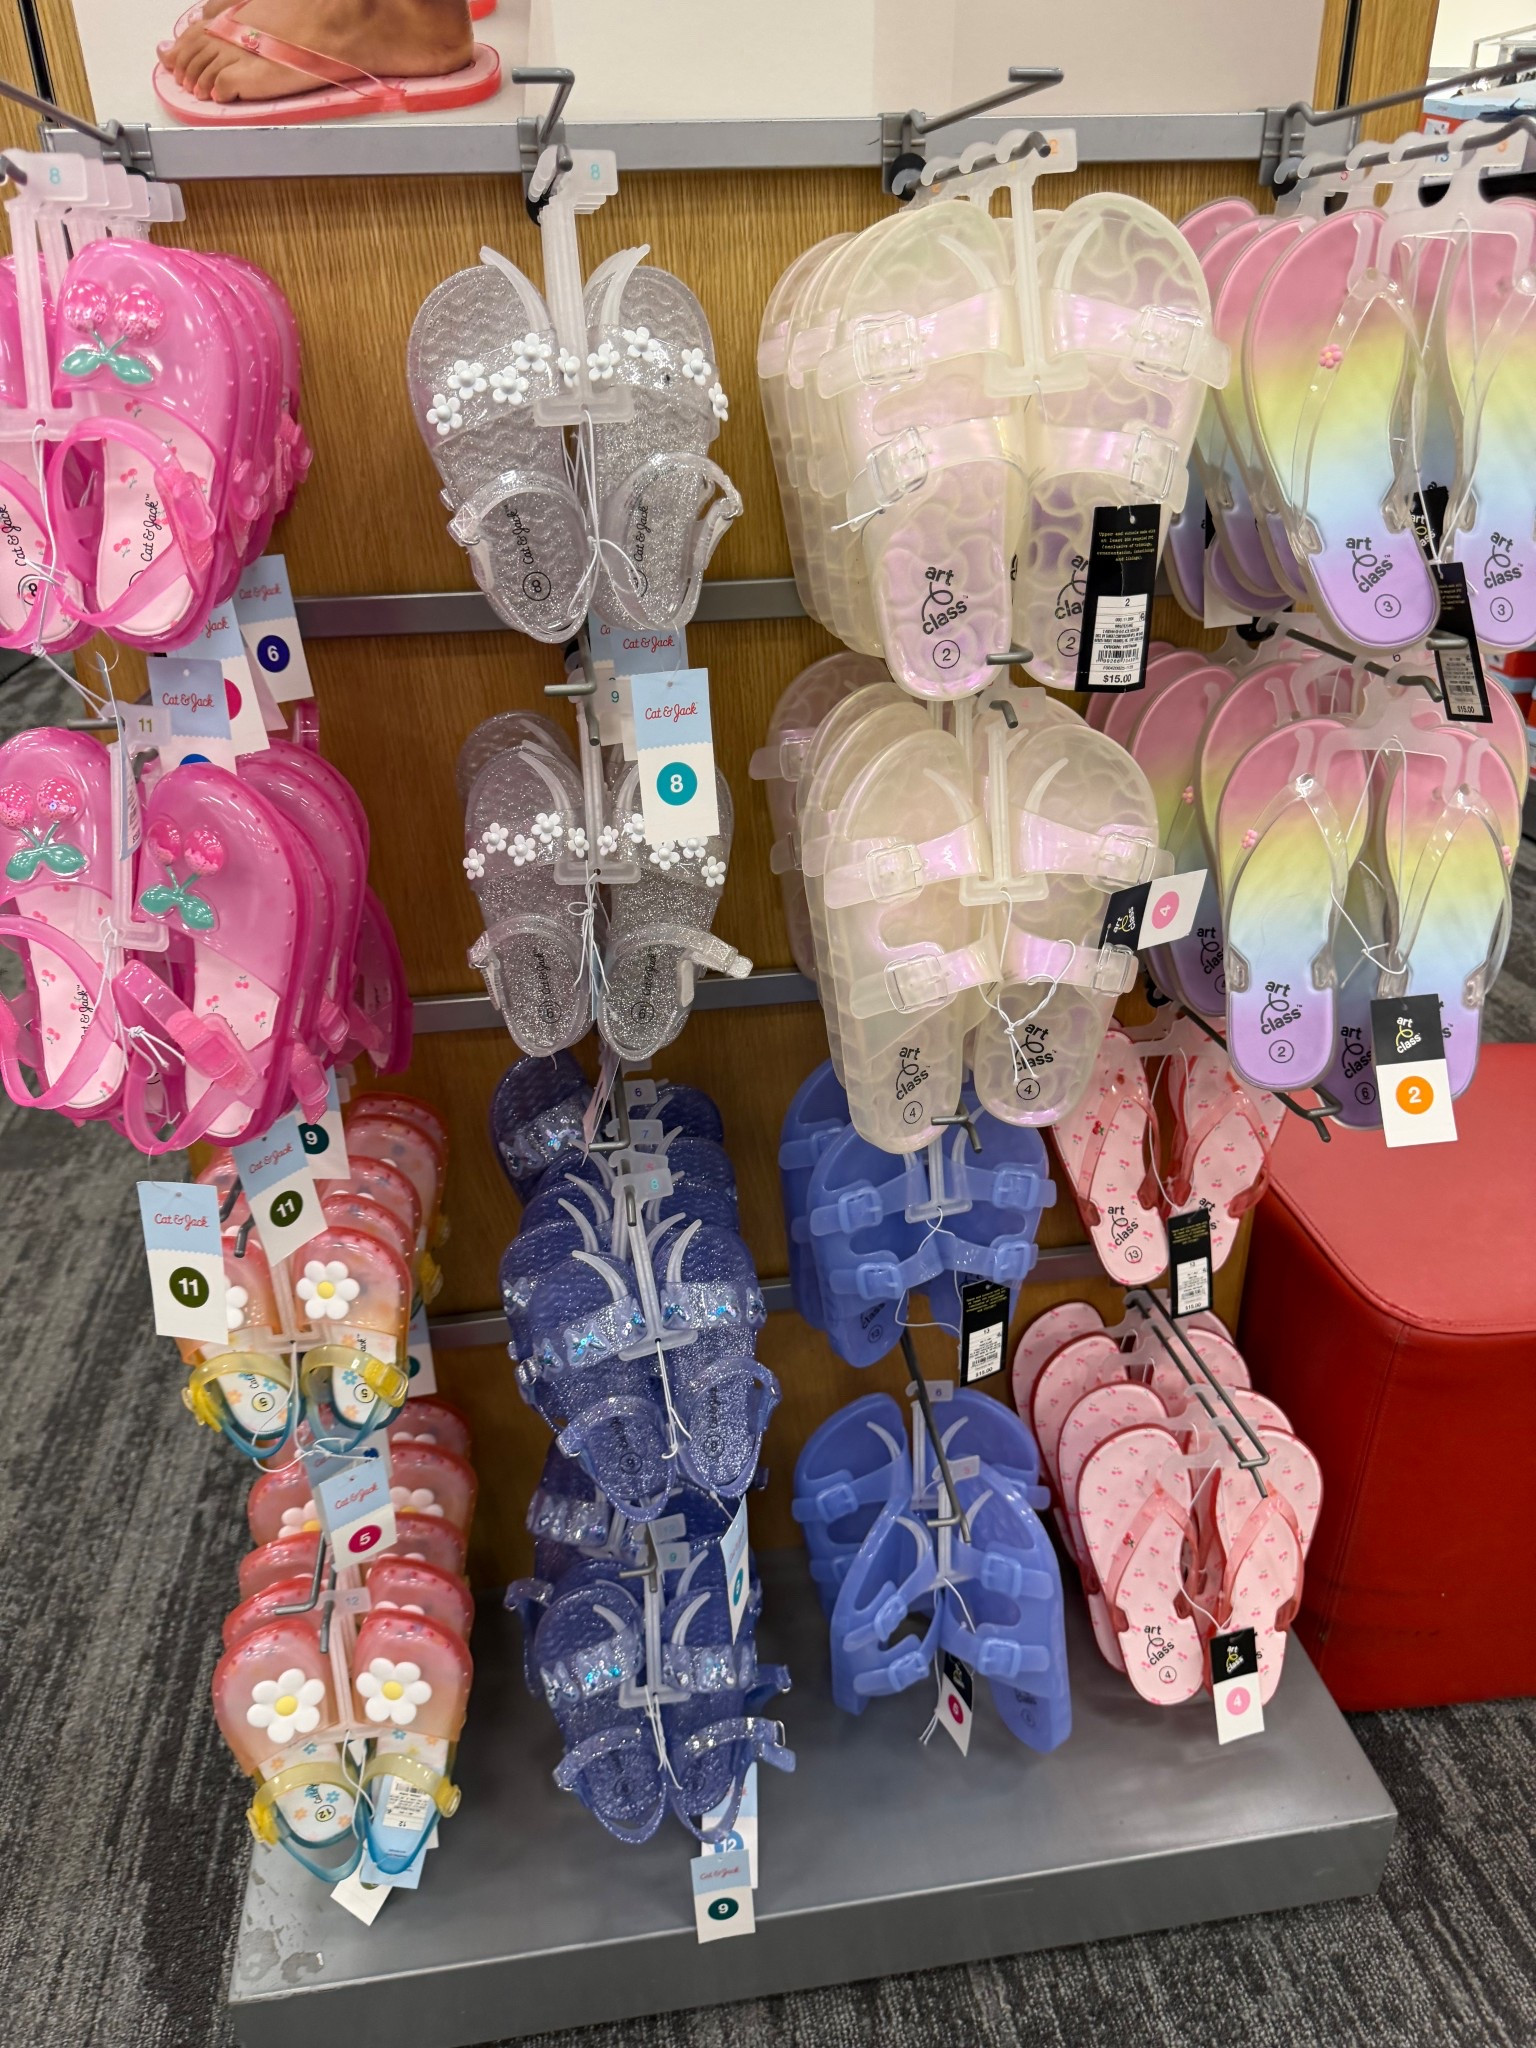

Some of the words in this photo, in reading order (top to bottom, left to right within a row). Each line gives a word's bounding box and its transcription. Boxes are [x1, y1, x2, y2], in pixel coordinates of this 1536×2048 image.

[50, 167, 61, 184] 8
[590, 164, 600, 180] 8
[143, 501, 162, 531] Jack
[507, 509, 530, 534] Jack
[637, 505, 651, 533] Jack
[8, 535, 19, 545] &
[143, 529, 155, 540] &
[517, 536, 527, 546] &
[636, 533, 646, 543] &
[1346, 537, 1372, 551] art
[1490, 532, 1514, 552] art
[141, 544, 153, 562] Cat
[522, 546, 534, 564] Cat
[633, 544, 645, 561] Cat
[1071, 555, 1088, 572] ar
[925, 566, 954, 586] art
[1358, 559, 1393, 593] class
[1484, 567, 1522, 589] class
[239, 588, 252, 599] Cat
[262, 584, 282, 601] Jack
[532, 580, 541, 593] 8
[1125, 598, 1131, 607] 2
[1382, 601, 1393, 612] 3
[1054, 600, 1084, 620] cla
[1497, 604, 1506, 616] 3
[923, 600, 968, 635] class
[623, 638, 639, 649] Cat
[640, 637, 651, 648] &
[650, 635, 675, 653] Jack
[1066, 637, 1075, 649] 2
[267, 645, 280, 662] 6
[942, 648, 951, 661] 2
[1103, 674, 1132, 683] $15.00
[162, 693, 180, 705] Cat
[181, 696, 191, 706] &
[190, 693, 215, 712] Jack
[611, 690, 619, 703] 9
[645, 707, 662, 720] Cat
[663, 706, 673, 717] &
[673, 702, 698, 723] Jack
[138, 718, 152, 732] 11
[669, 774, 684, 794] 8
[1160, 904, 1171, 917] 4
[1113, 917, 1123, 933] art
[1197, 927, 1216, 939] art
[1265, 981, 1290, 997] art
[80, 1014, 90, 1024] &
[1260, 1007, 1302, 1035] class
[1396, 1016, 1413, 1028] art
[1025, 1024, 1049, 1040] art
[1340, 1026, 1362, 1040] art
[1396, 1034, 1422, 1054] class
[899, 1047, 920, 1060] art
[1278, 1046, 1286, 1058] 2
[1013, 1052, 1054, 1072] class
[896, 1069, 929, 1100] class
[1023, 1084, 1032, 1094] 4
[635, 1087, 642, 1098] 6
[1408, 1086, 1422, 1104] 2
[909, 1108, 916, 1117] 4
[306, 1131, 317, 1145] 9
[249, 1159, 263, 1174] Cat
[264, 1155, 273, 1165] &
[273, 1143, 293, 1166] Jack
[651, 1178, 659, 1190] 8
[276, 1199, 295, 1218] 11
[1107, 1204, 1125, 1215] art
[1199, 1197, 1216, 1212] art
[154, 1213, 173, 1225] Cat
[174, 1214, 184, 1225] &
[184, 1214, 209, 1231] Jack
[1114, 1221, 1139, 1247] class
[1128, 1250, 1139, 1261] 13
[178, 1278, 199, 1297] 11
[362, 1388, 369, 1398] 5
[260, 1397, 268, 1407] 5
[360, 1532, 371, 1545] 5
[1144, 1625, 1161, 1635] art
[1149, 1642, 1175, 1666] class
[1165, 1671, 1171, 1679] 4
[1233, 1695, 1241, 1707] 4
[318, 1808, 334, 1821] 12
[721, 1838, 736, 1851] 12
[718, 1902, 729, 1914] 9
